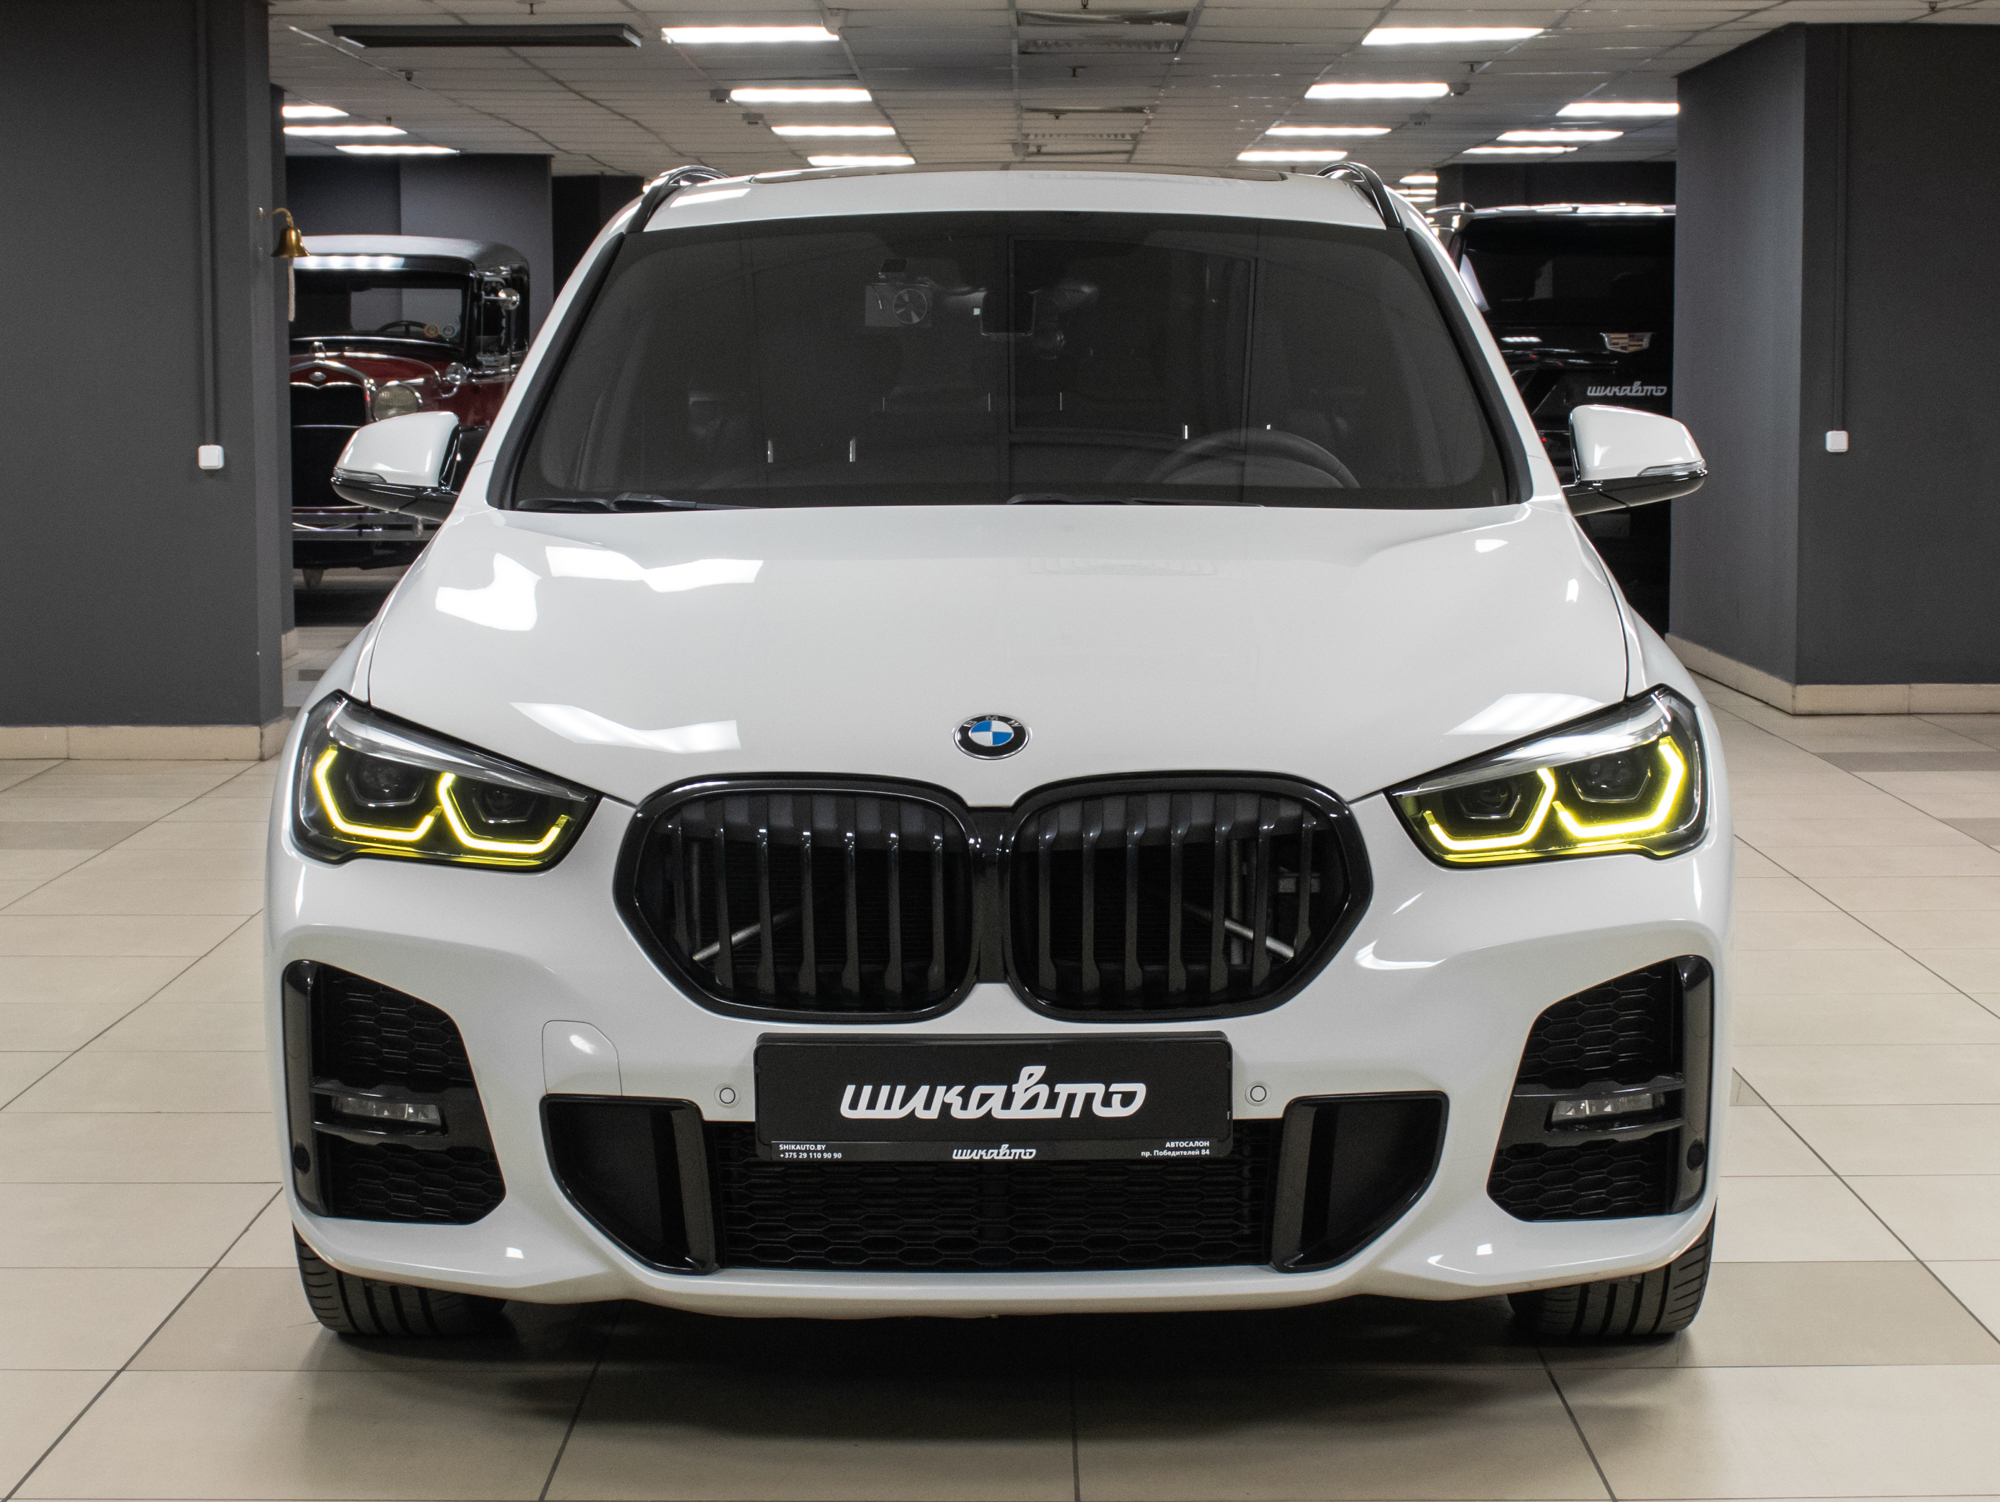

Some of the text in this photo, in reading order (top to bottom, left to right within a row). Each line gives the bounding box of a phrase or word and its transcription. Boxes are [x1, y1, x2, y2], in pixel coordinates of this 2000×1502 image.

[1587, 381, 1667, 396] шикавто
[963, 715, 1022, 727] BMW
[840, 1065, 1146, 1119] шикавто
[952, 1143, 1036, 1159] шикавто
[1153, 1149, 1200, 1157] Победителей
